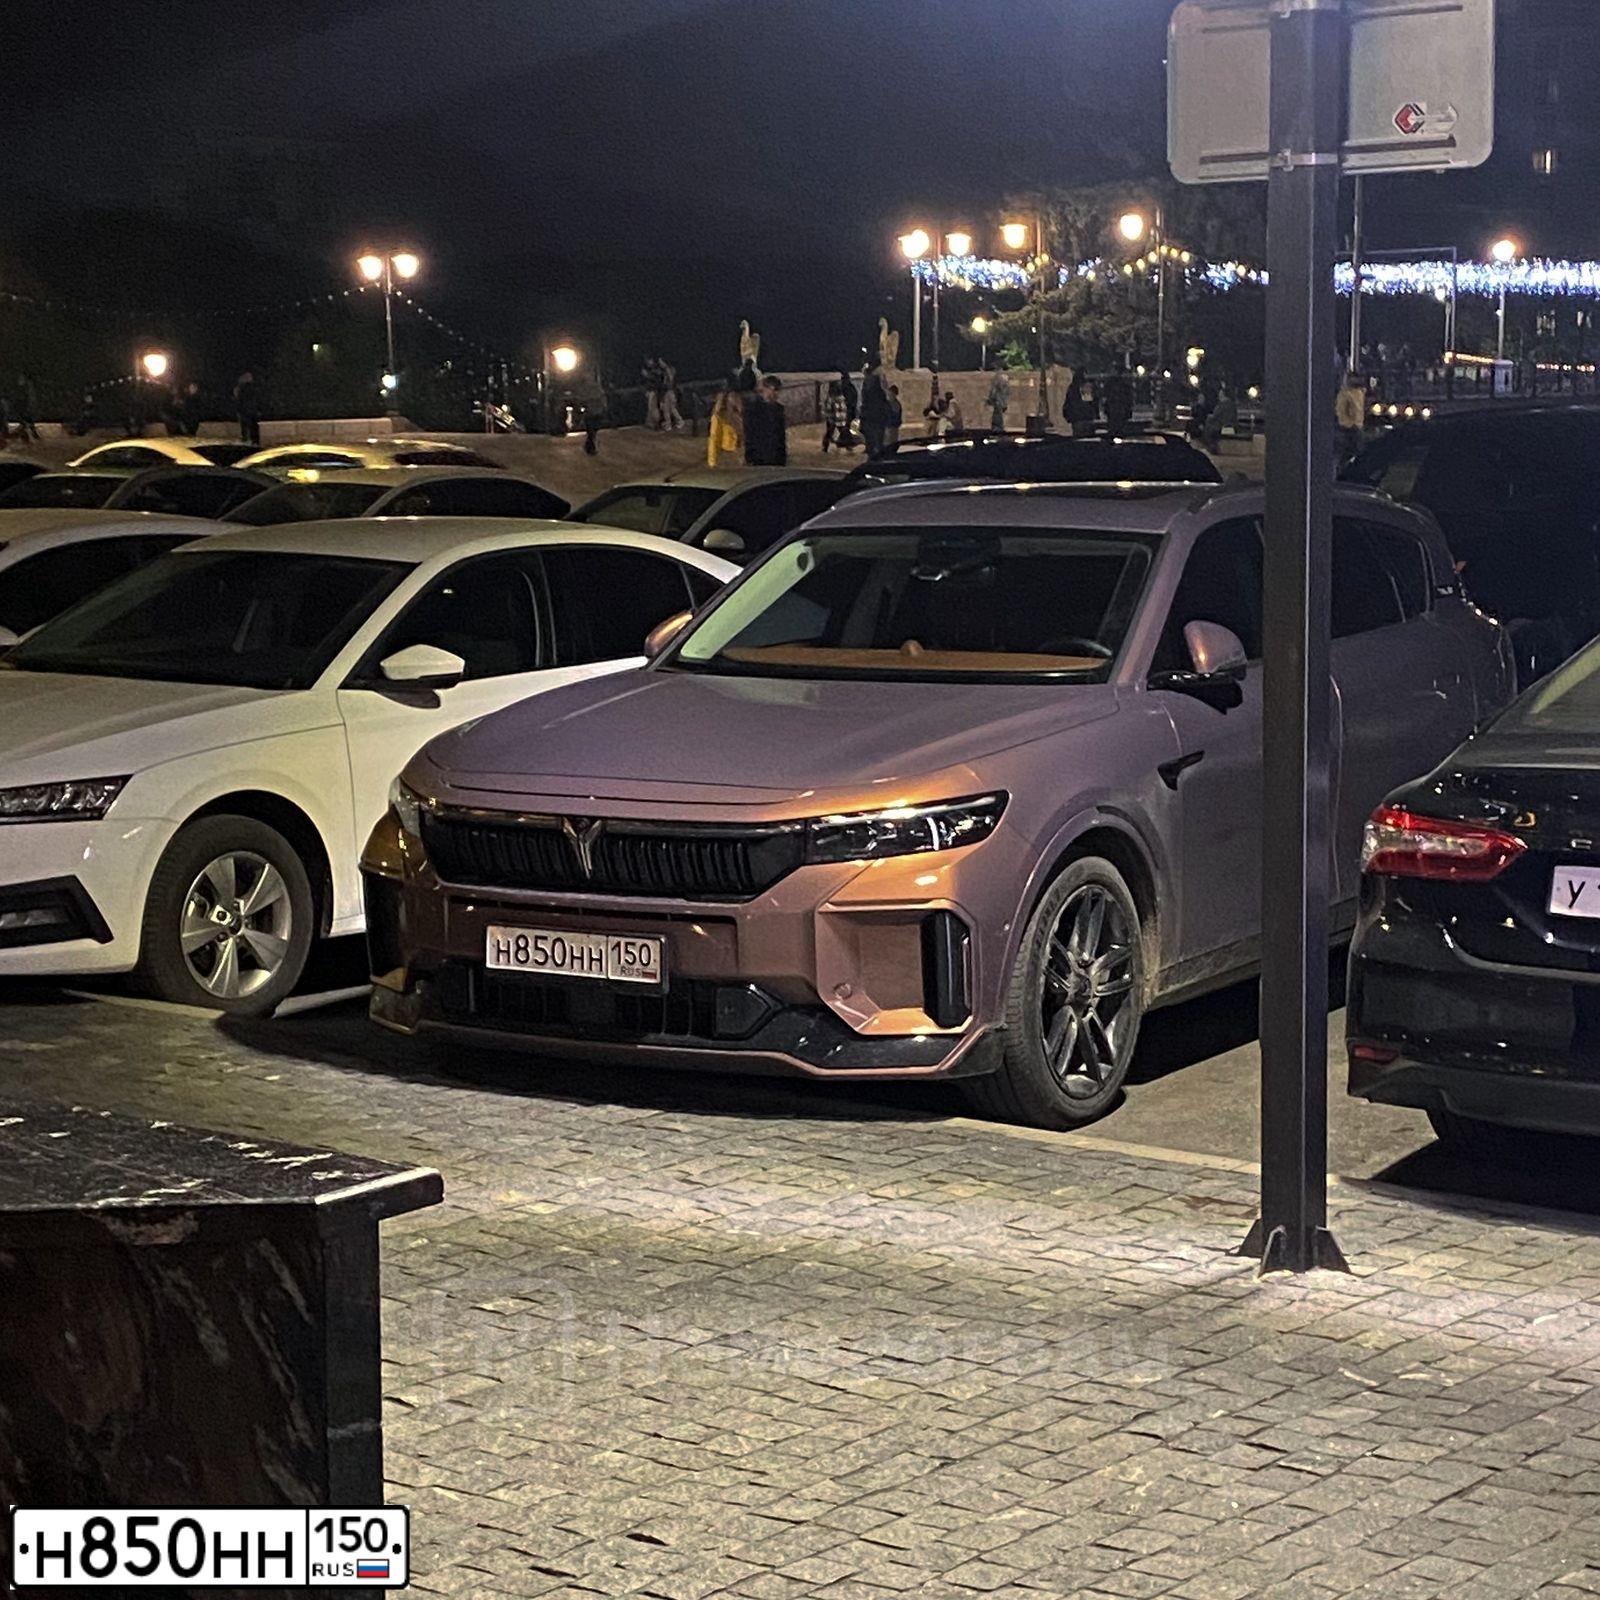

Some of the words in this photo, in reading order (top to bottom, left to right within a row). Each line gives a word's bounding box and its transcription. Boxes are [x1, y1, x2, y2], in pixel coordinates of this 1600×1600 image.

[495, 934, 604, 973] Н850НН
[610, 940, 651, 968] 150
[620, 967, 642, 978] RUS
